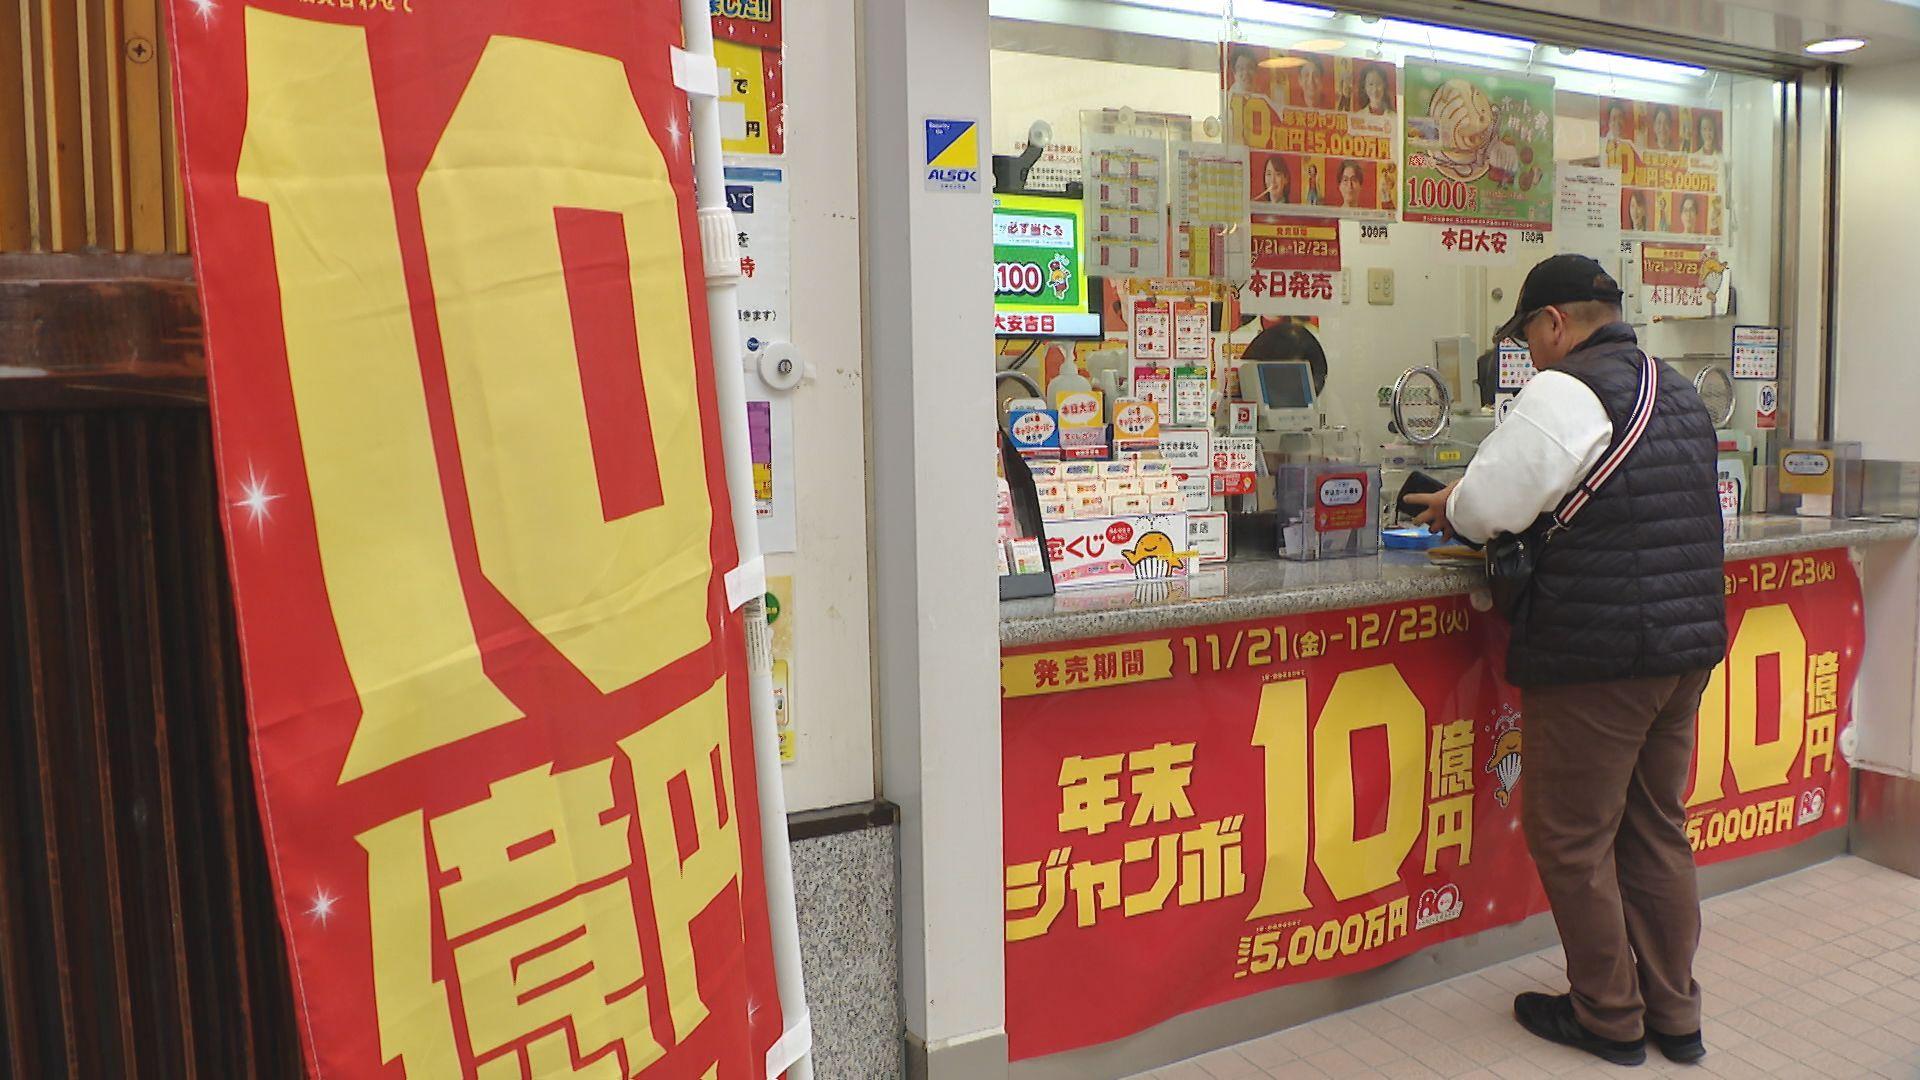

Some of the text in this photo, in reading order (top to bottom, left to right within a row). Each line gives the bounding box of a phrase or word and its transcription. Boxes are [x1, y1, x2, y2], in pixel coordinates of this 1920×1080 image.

[745, 121, 760, 138] 円
[1229, 95, 1271, 149] 10
[927, 168, 977, 182] ALSOK
[1407, 177, 1467, 210] 1,000
[1360, 225, 1388, 238] 300円
[1441, 227, 1508, 253] 本日大安
[1520, 231, 1544, 243] 100円
[1248, 271, 1333, 300] 本日発売
[1650, 285, 1703, 306] 本日発売
[994, 314, 1055, 332] 大安吉日
[236, 4, 713, 785] 10
[1045, 534, 1105, 562] 宝くじ
[1034, 648, 1145, 688] 発売期間
[1804, 652, 1840, 780] 億円
[1057, 741, 1197, 835] 年末
[1245, 663, 1427, 922] 10
[1422, 719, 1477, 876] 億円
[1005, 813, 1246, 942] ジャンボ
[1250, 895, 1410, 975] 5,000万円
